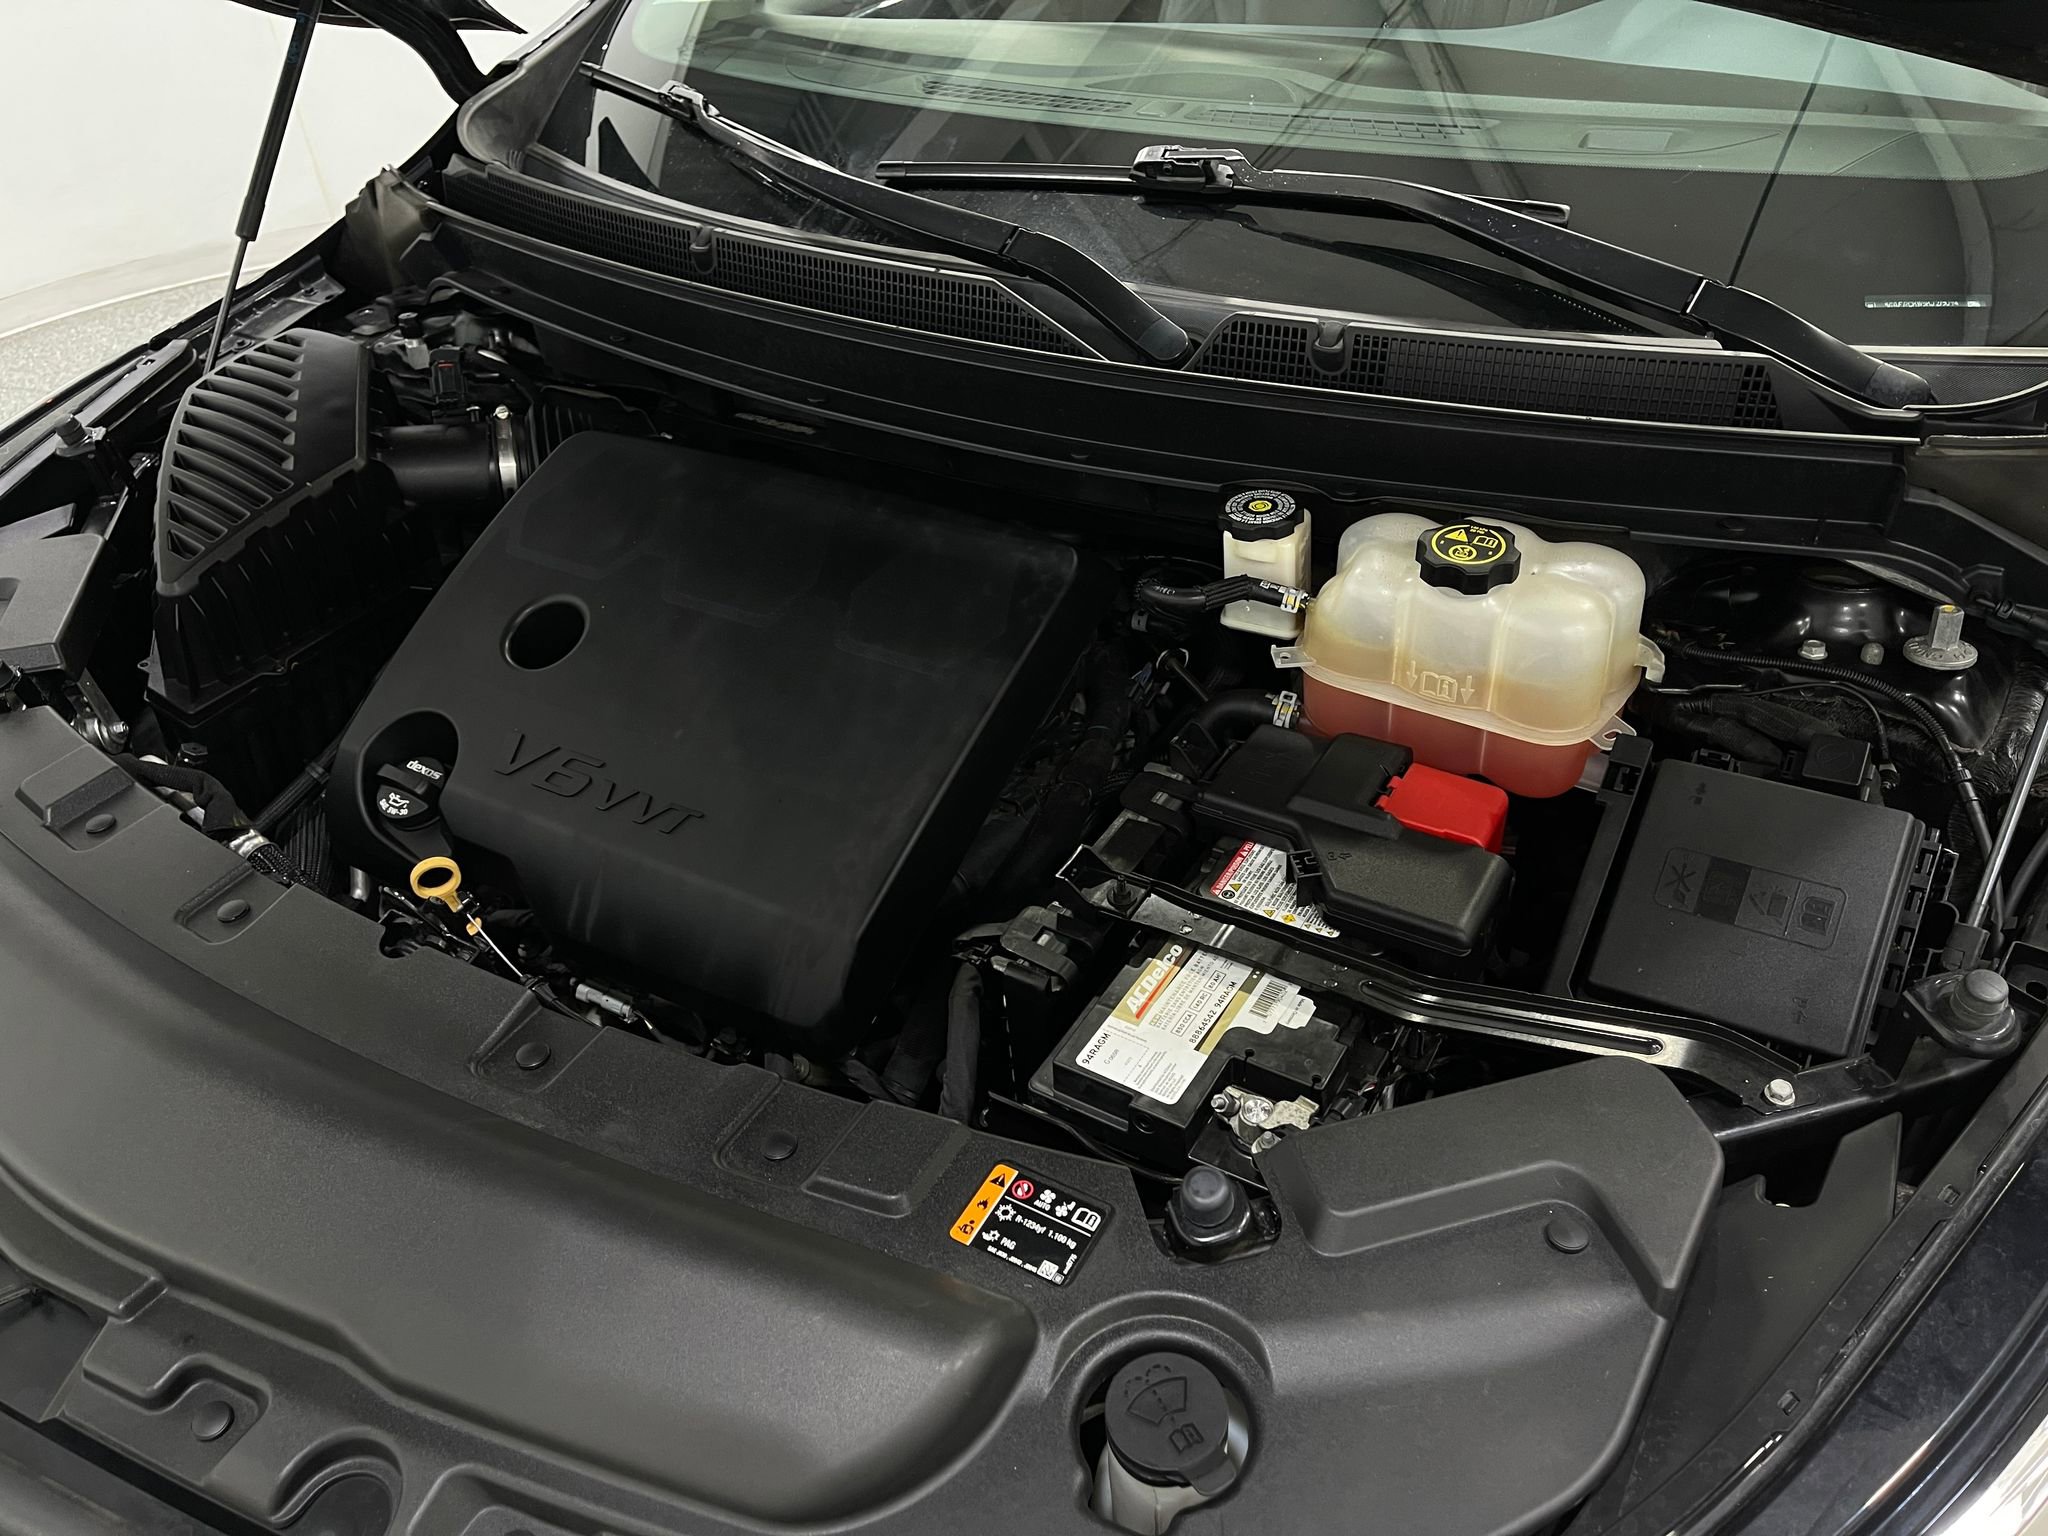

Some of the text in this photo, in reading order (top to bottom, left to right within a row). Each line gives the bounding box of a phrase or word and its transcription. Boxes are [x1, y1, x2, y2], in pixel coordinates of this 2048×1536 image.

[406, 760, 442, 779] dexos
[1193, 952, 1208, 967] BATTE
[1126, 944, 1182, 1013] ACDelco
[1188, 980, 1237, 1043] 88864542 94RAGM
[1193, 1000, 1202, 1009] 140
[1175, 1013, 1192, 1033] 850 CCA
[1081, 1032, 1111, 1064] 94RAGM
[1033, 1199, 1051, 1211] AUTO
[1015, 1214, 1076, 1250] R-1234yf 1.100 kg
[1000, 1236, 1016, 1250] PAG
